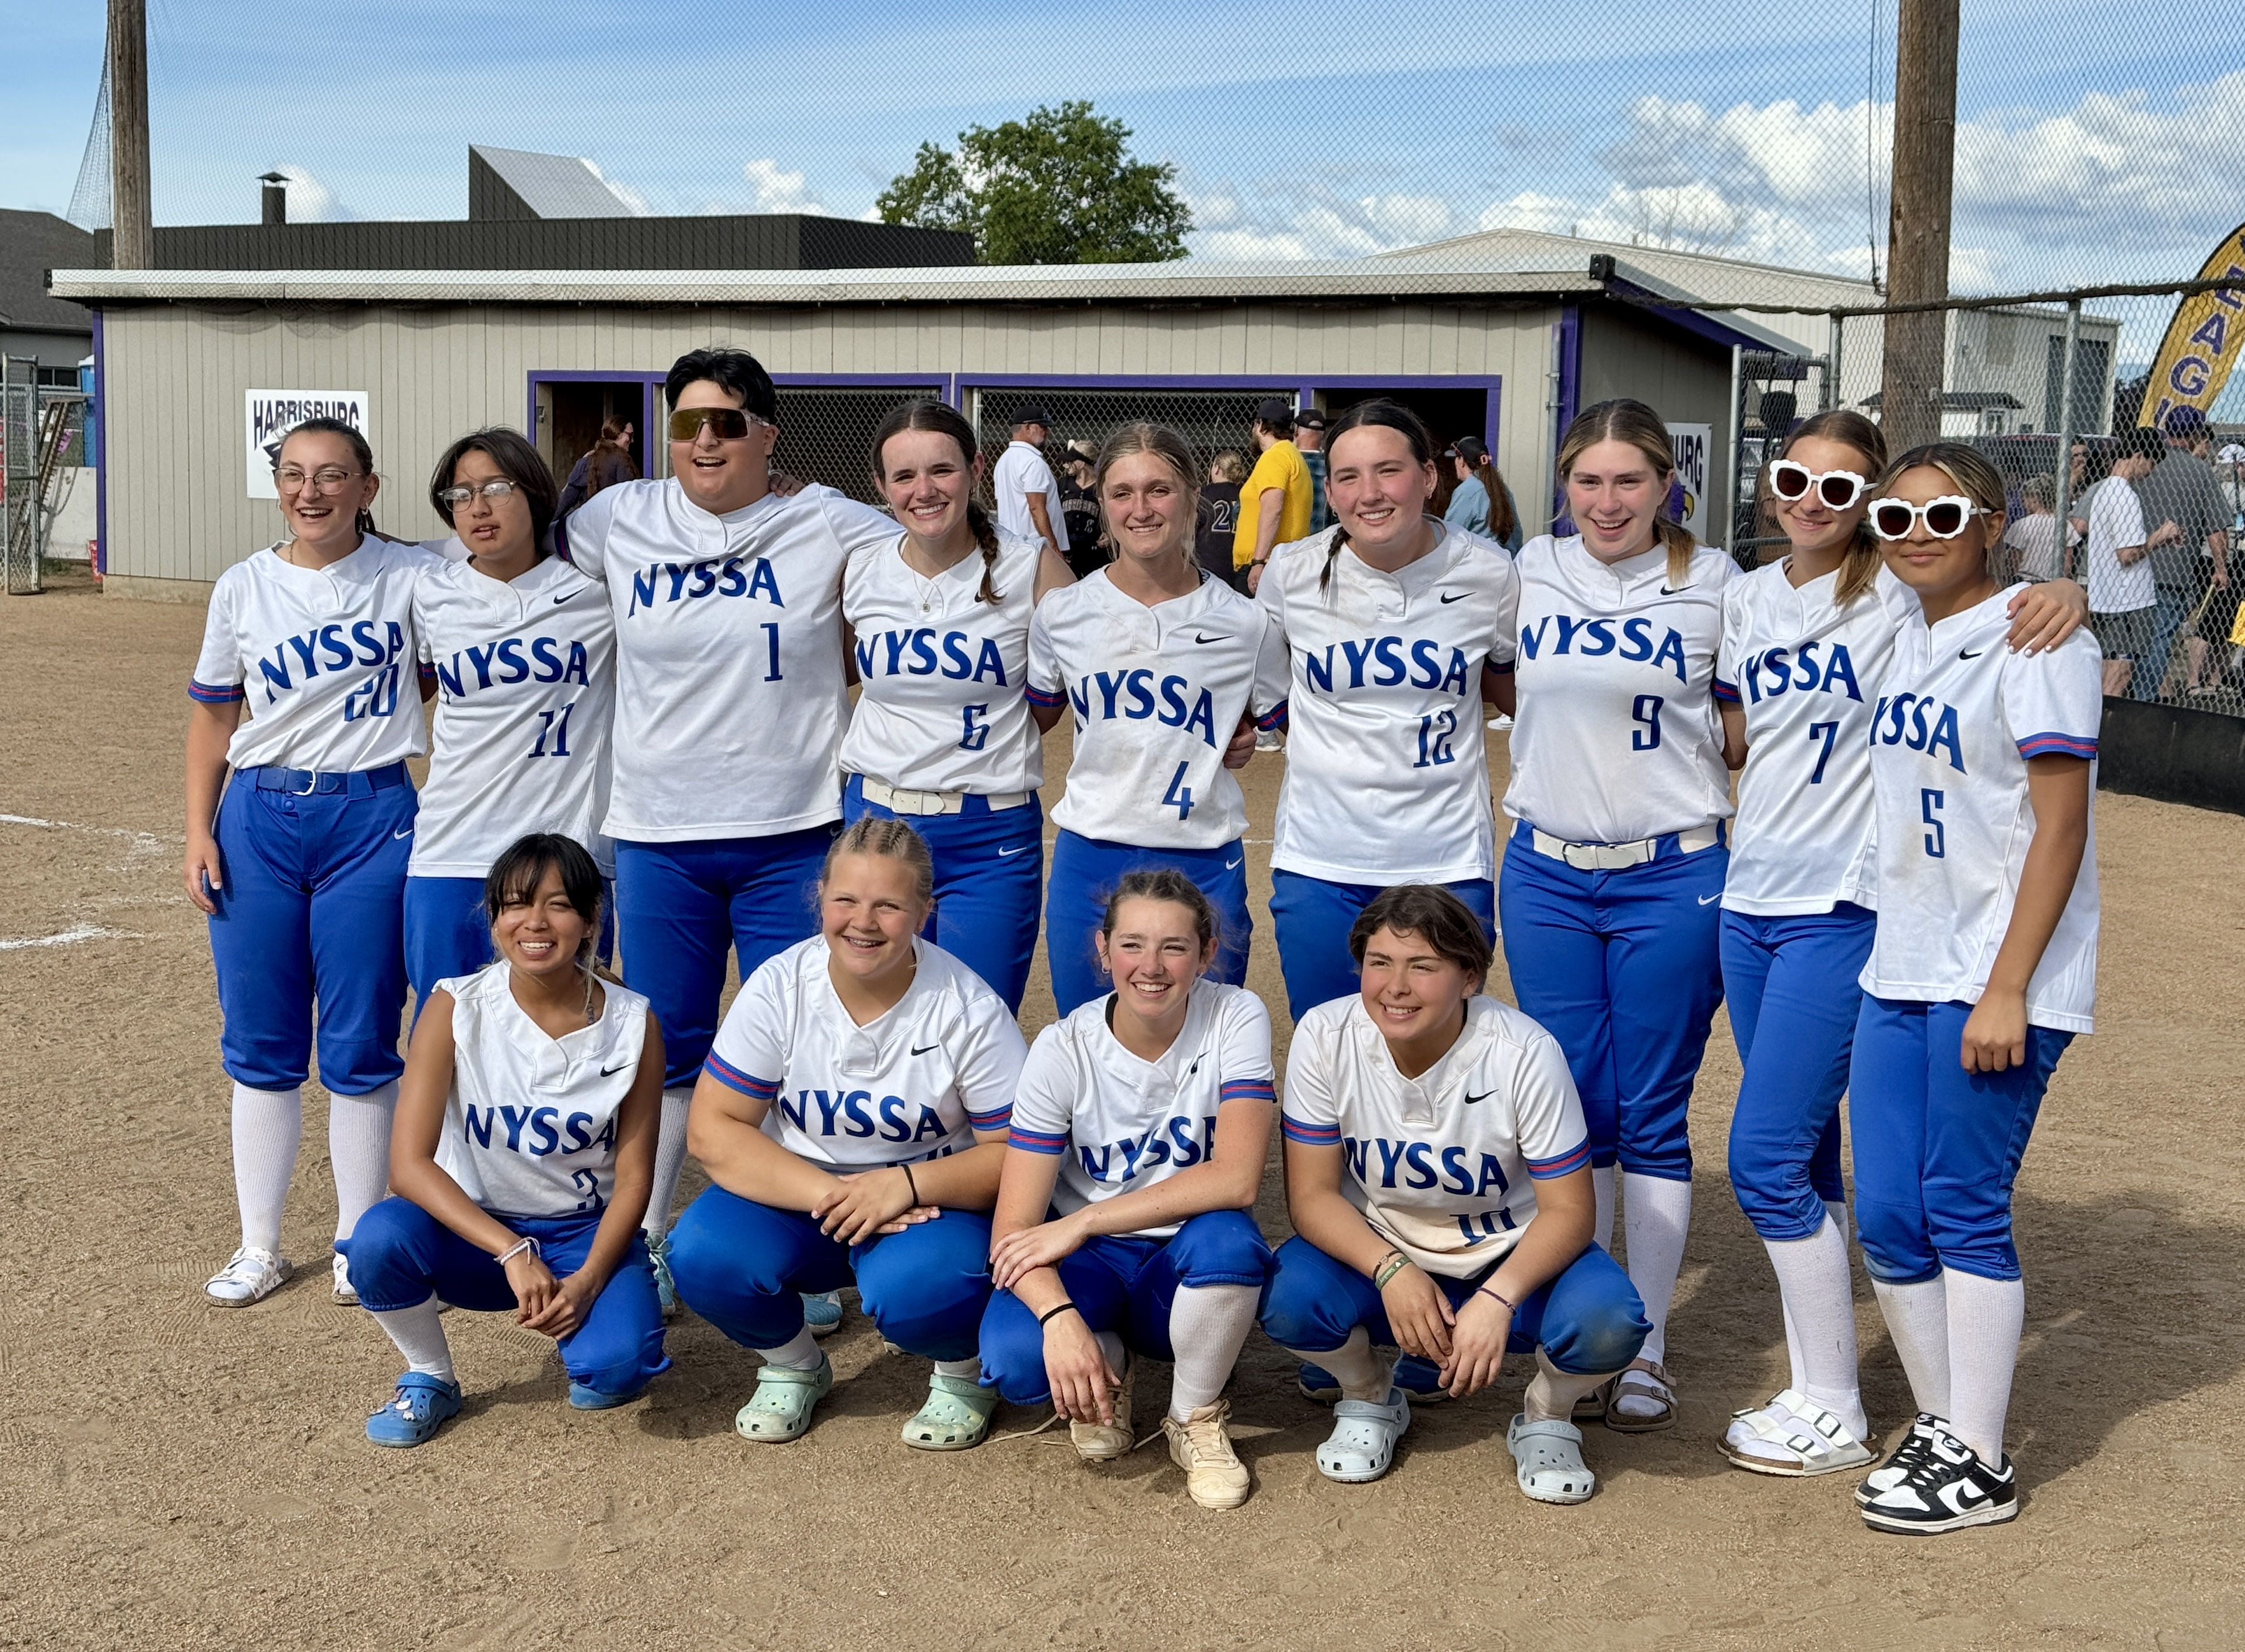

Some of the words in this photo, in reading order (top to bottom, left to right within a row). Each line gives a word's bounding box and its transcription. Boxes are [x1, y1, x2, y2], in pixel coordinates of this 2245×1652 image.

[628, 557, 784, 619] NYSSA
[258, 620, 405, 704] NYSSA
[437, 637, 589, 704] NYSSA
[760, 622, 783, 682] 1
[857, 627, 1008, 688] NYSSA
[1306, 636, 1469, 697] NYSSA
[1517, 615, 1687, 686] NYSSA
[1738, 641, 1865, 705] YSSA
[528, 703, 575, 758] 11
[958, 703, 990, 750] 6
[1069, 669, 1217, 749] NYSSA
[1413, 710, 1457, 767] 12
[1632, 694, 1664, 750] 9
[1869, 692, 1967, 775] YSSA
[1809, 721, 1840, 784] 7
[1162, 760, 1195, 820] 4
[1921, 788, 1945, 858] 5
[465, 1103, 615, 1157] NYSSA
[780, 1090, 948, 1143] NYSSA
[1344, 1137, 1509, 1197] NYSSA
